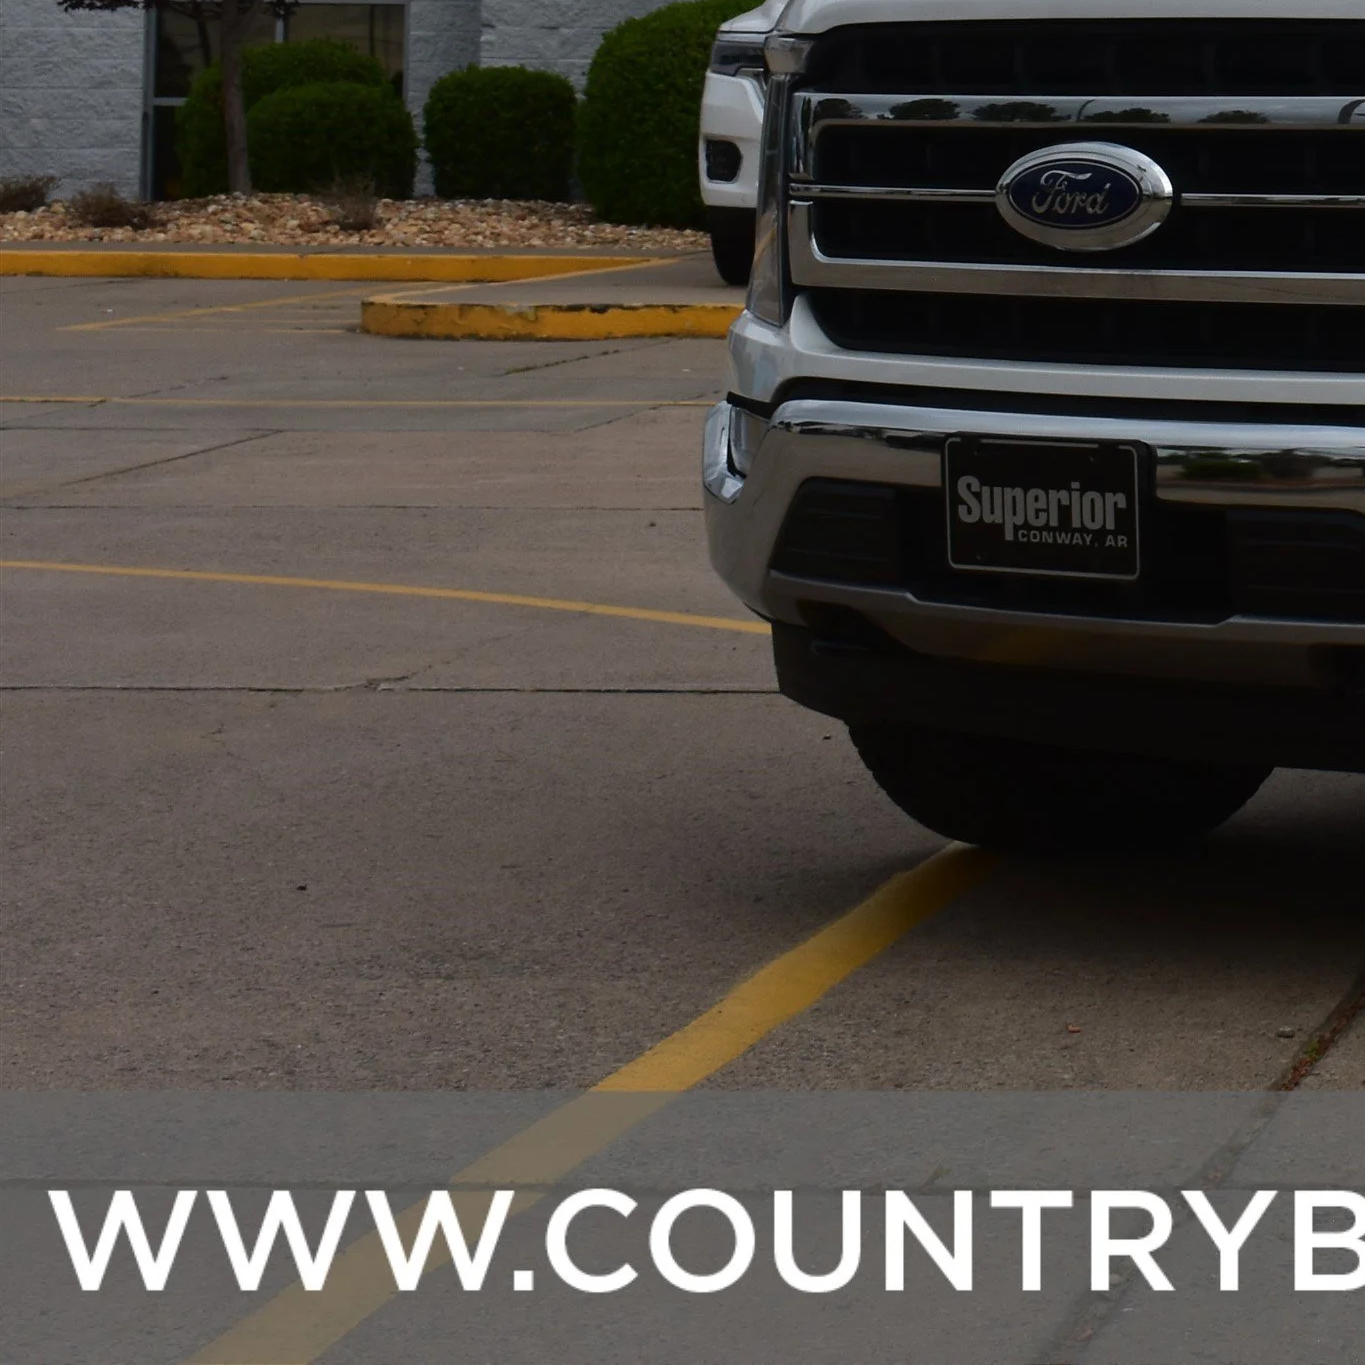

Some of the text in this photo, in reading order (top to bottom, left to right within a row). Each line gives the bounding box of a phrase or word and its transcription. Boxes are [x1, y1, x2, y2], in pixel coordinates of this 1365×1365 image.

[1031, 169, 1111, 215] Ford
[957, 475, 1127, 540] Superior
[1018, 530, 1128, 547] CONWAY, AR
